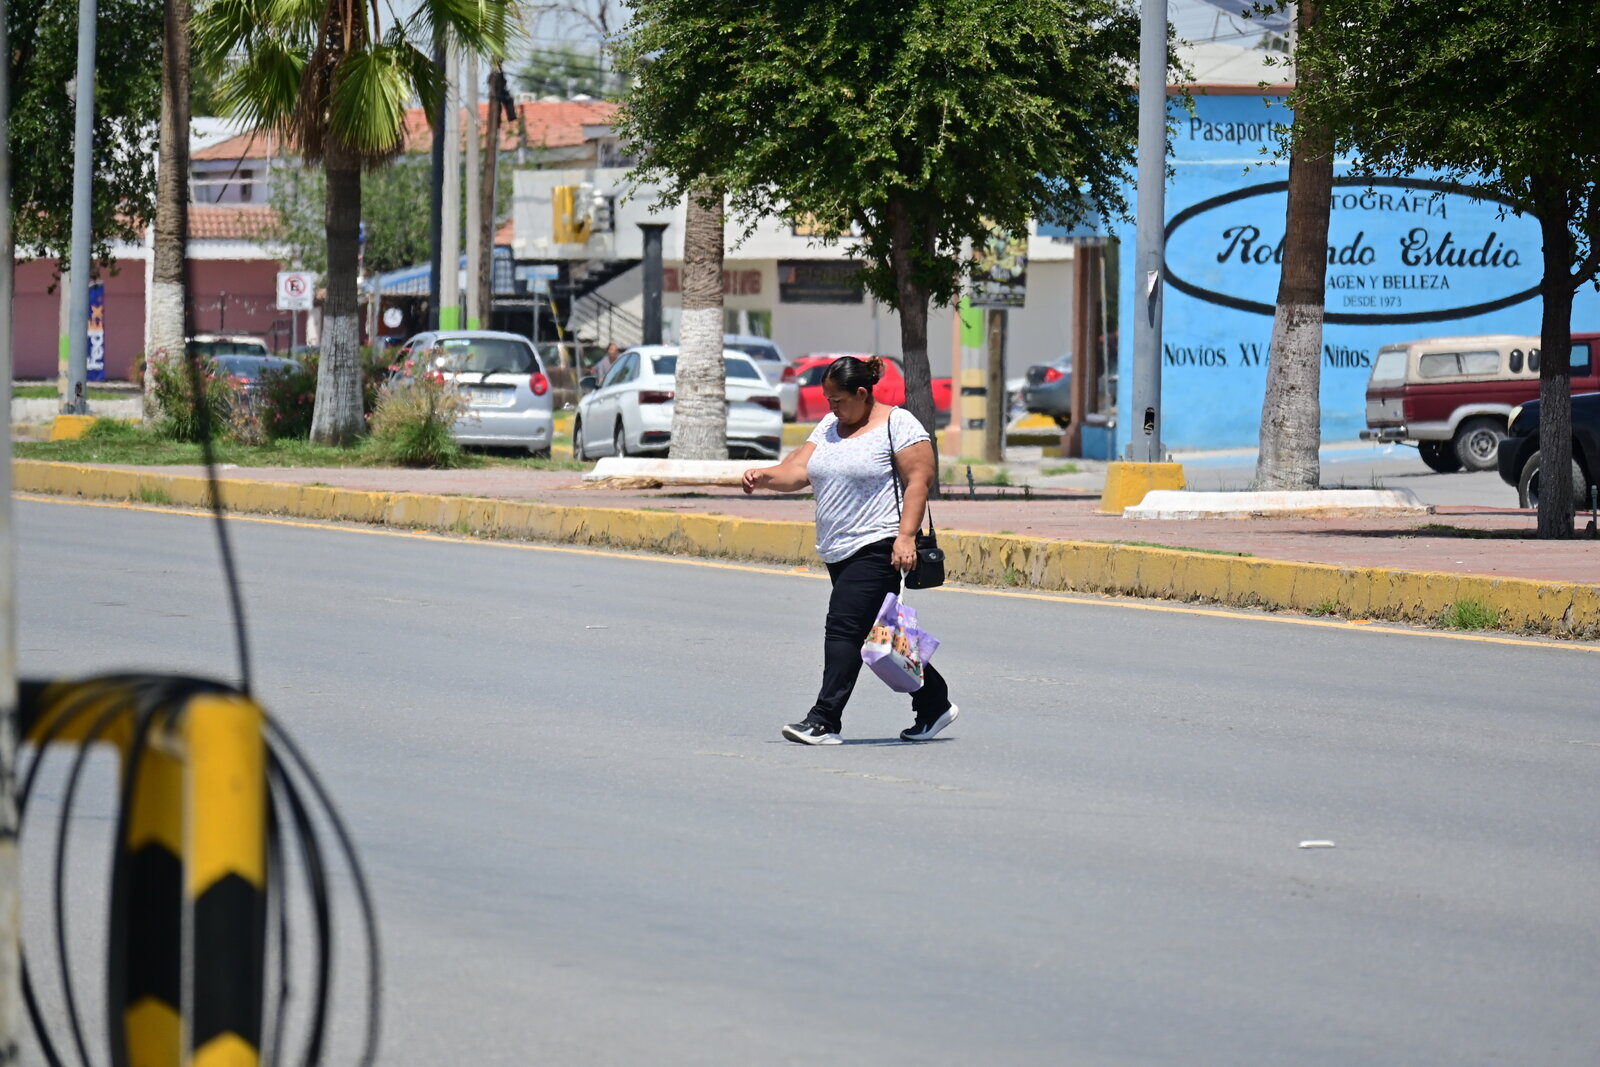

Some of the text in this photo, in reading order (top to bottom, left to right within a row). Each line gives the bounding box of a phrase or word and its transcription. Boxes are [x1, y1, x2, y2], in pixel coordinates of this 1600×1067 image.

[1216, 224, 1521, 268] Rolndo Estudio
[1327, 274, 1450, 290] AGEN Y BELLEZA
[1343, 295, 1402, 308] DESDE 1973
